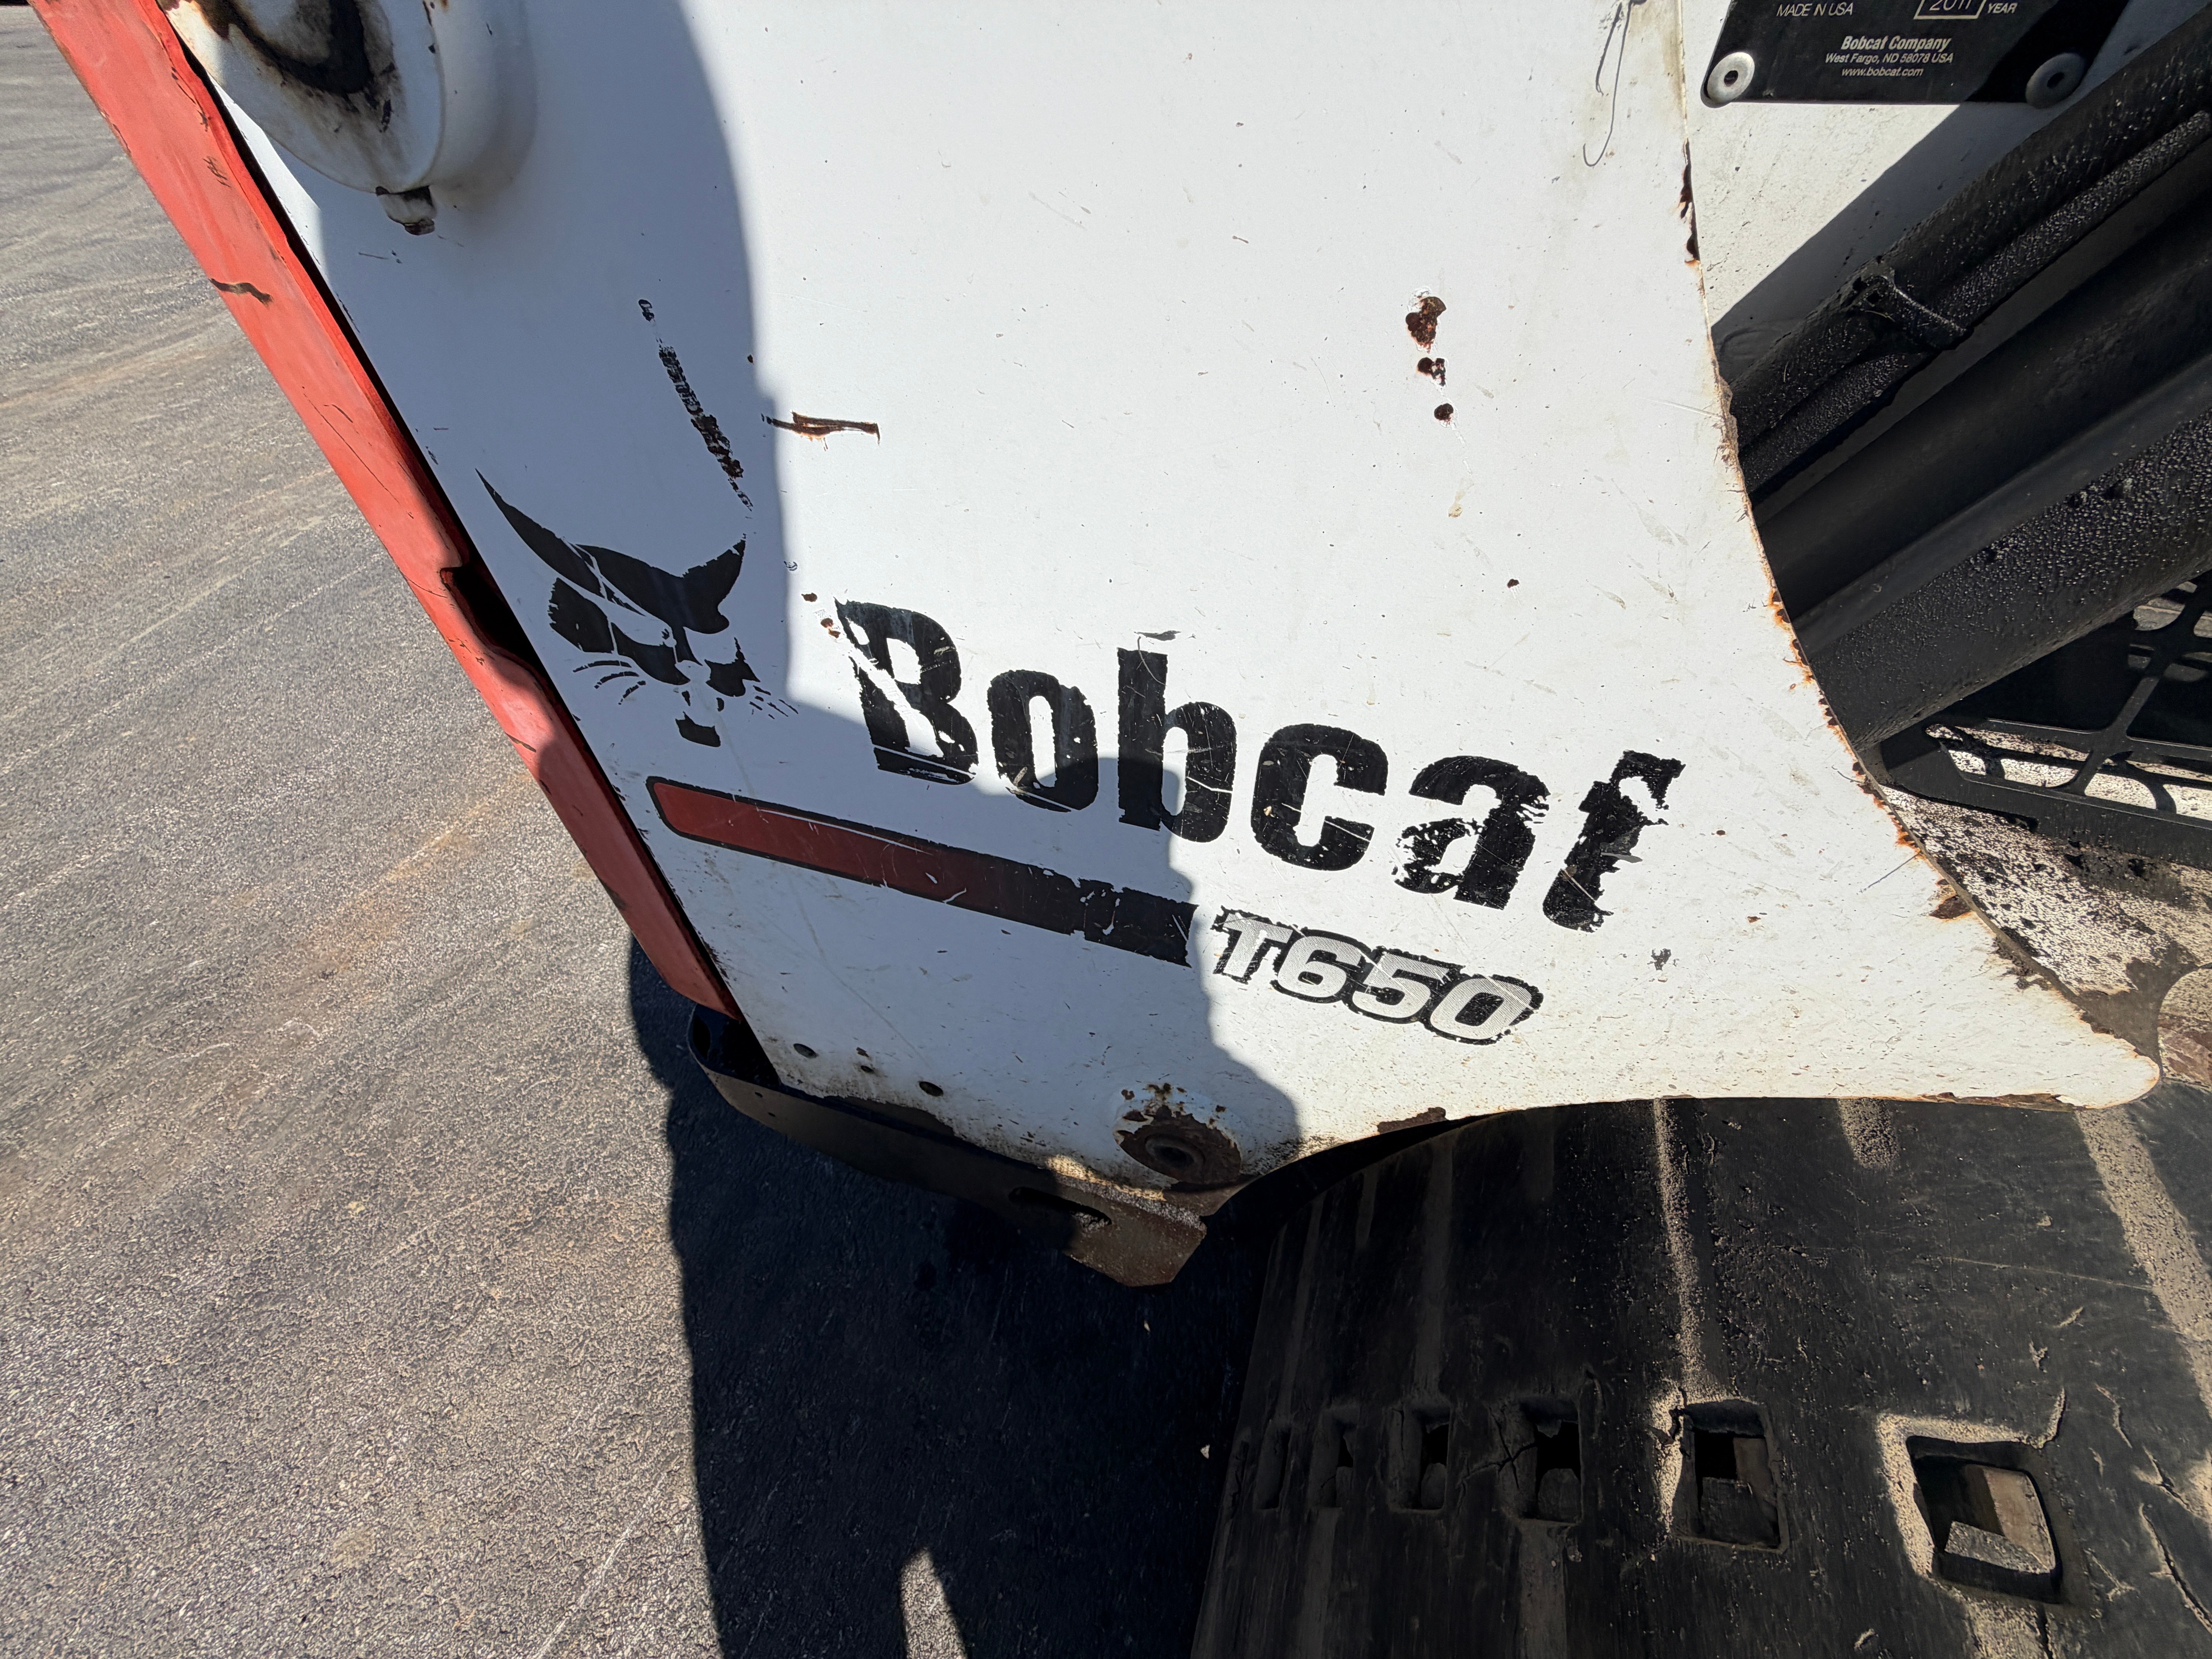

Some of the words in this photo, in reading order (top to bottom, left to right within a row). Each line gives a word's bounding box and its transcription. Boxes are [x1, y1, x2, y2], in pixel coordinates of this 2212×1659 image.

[1776, 3, 1812, 17] MADE
[1828, 2, 1854, 16] USA
[1987, 3, 2018, 14] YEAR
[1841, 35, 1889, 50] Bobcat
[1888, 35, 1952, 52] Company
[1825, 53, 1848, 64] West
[1850, 53, 1880, 65] Fargo,
[1882, 53, 1899, 63] ND
[1899, 53, 1930, 63] 58078
[1931, 53, 1954, 64] USA
[1841, 66, 1924, 76] www.bobcat.com
[835, 599, 1686, 933] Bobcat
[1214, 907, 1541, 1044] T650
